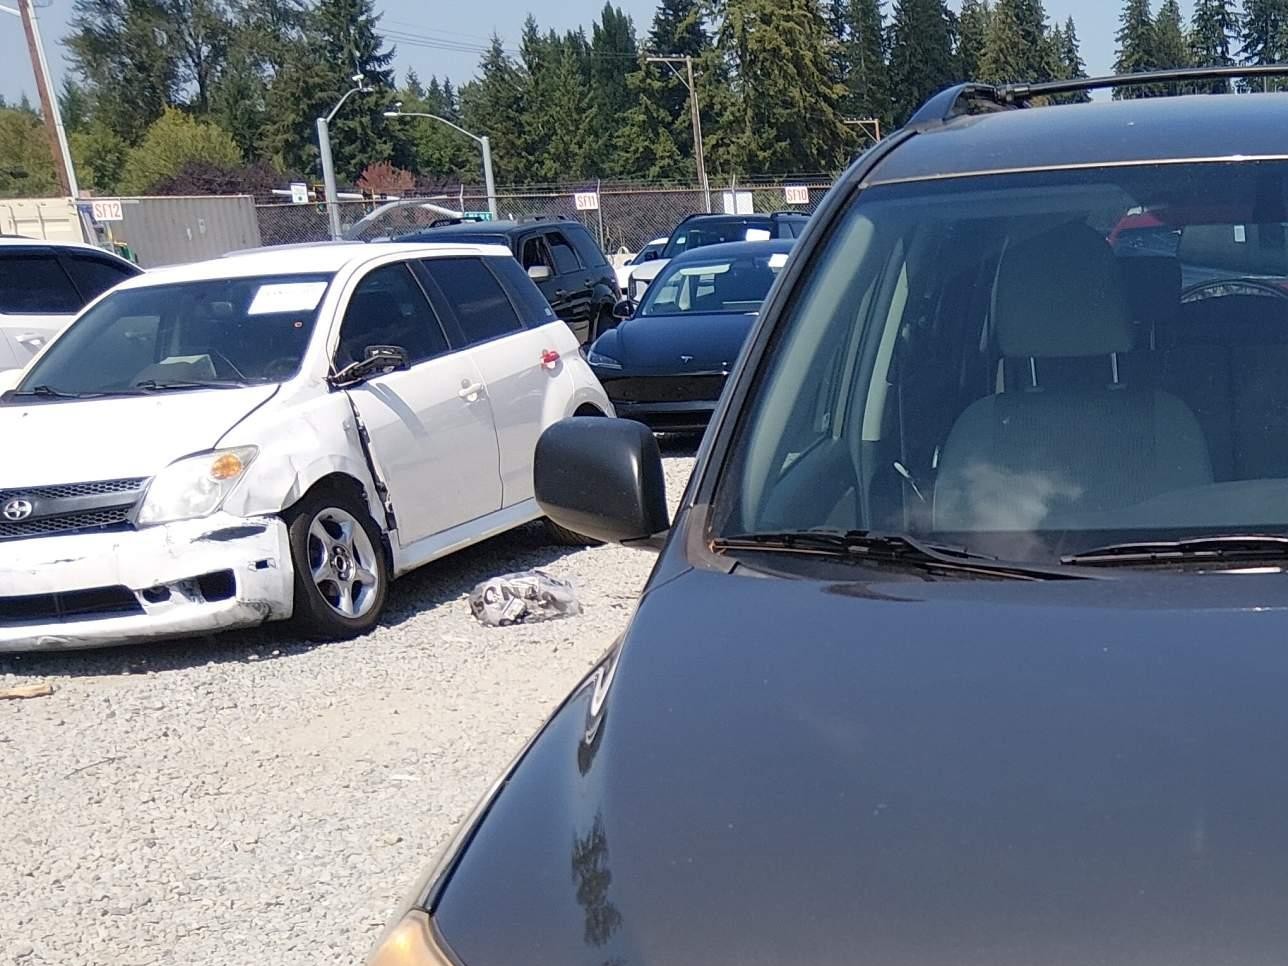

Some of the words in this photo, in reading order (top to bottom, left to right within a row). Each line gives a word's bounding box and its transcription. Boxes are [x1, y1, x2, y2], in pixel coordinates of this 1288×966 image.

[577, 195, 597, 208] SF11
[787, 188, 807, 202] SF10
[94, 202, 121, 218] SF12
